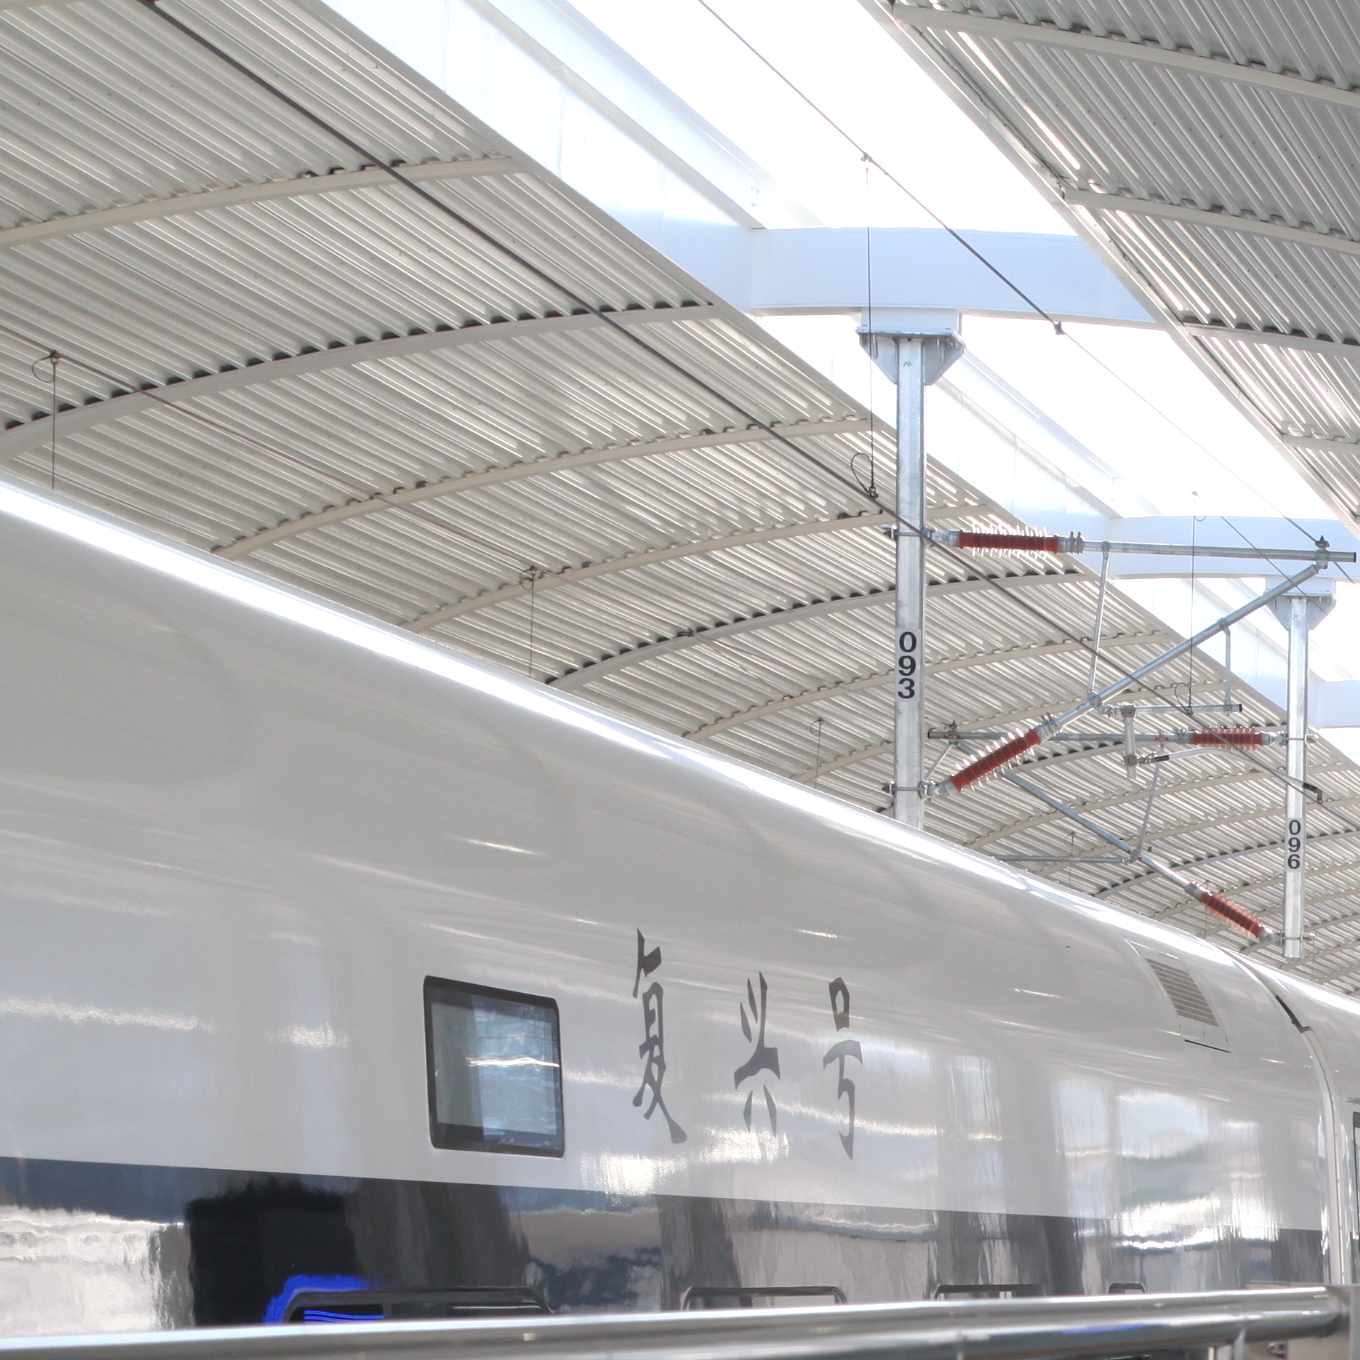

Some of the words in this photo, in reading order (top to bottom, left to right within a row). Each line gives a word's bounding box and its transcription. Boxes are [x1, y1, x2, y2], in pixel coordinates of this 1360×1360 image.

[898, 631, 917, 699] 093
[1288, 820, 1301, 869] 096
[632, 928, 863, 1160] 复兴号
